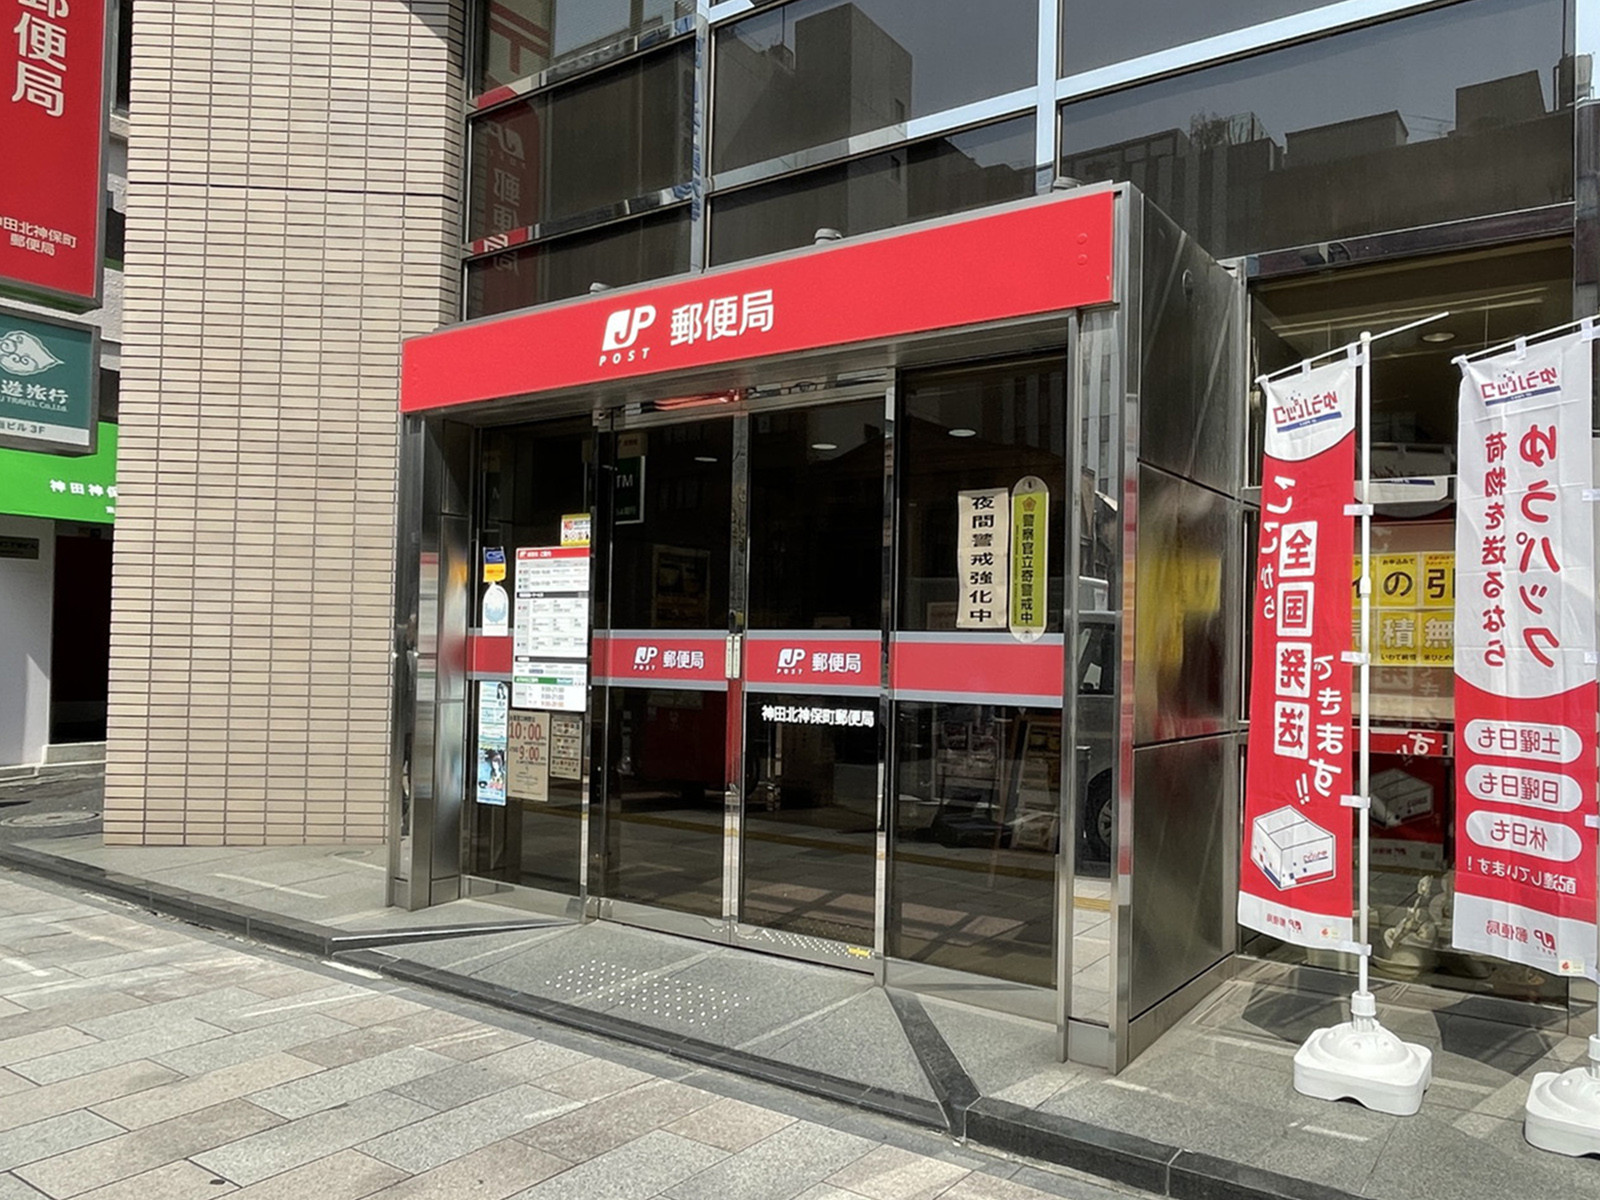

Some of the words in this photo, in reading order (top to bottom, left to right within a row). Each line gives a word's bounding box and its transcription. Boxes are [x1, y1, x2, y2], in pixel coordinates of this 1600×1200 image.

[0, 216, 77, 248] 田北神保町
[9, 233, 55, 256] 郵便局
[670, 289, 774, 346] 郵便局
[599, 347, 650, 367] POST
[30, 425, 45, 434] 3F
[969, 496, 994, 622] 夜間警戒強化中
[1020, 513, 1035, 624] 警察官立寄警戒中
[662, 650, 704, 670] 郵便局
[811, 653, 862, 673] 郵便局
[761, 704, 875, 729] 神田北神保町郵便局
